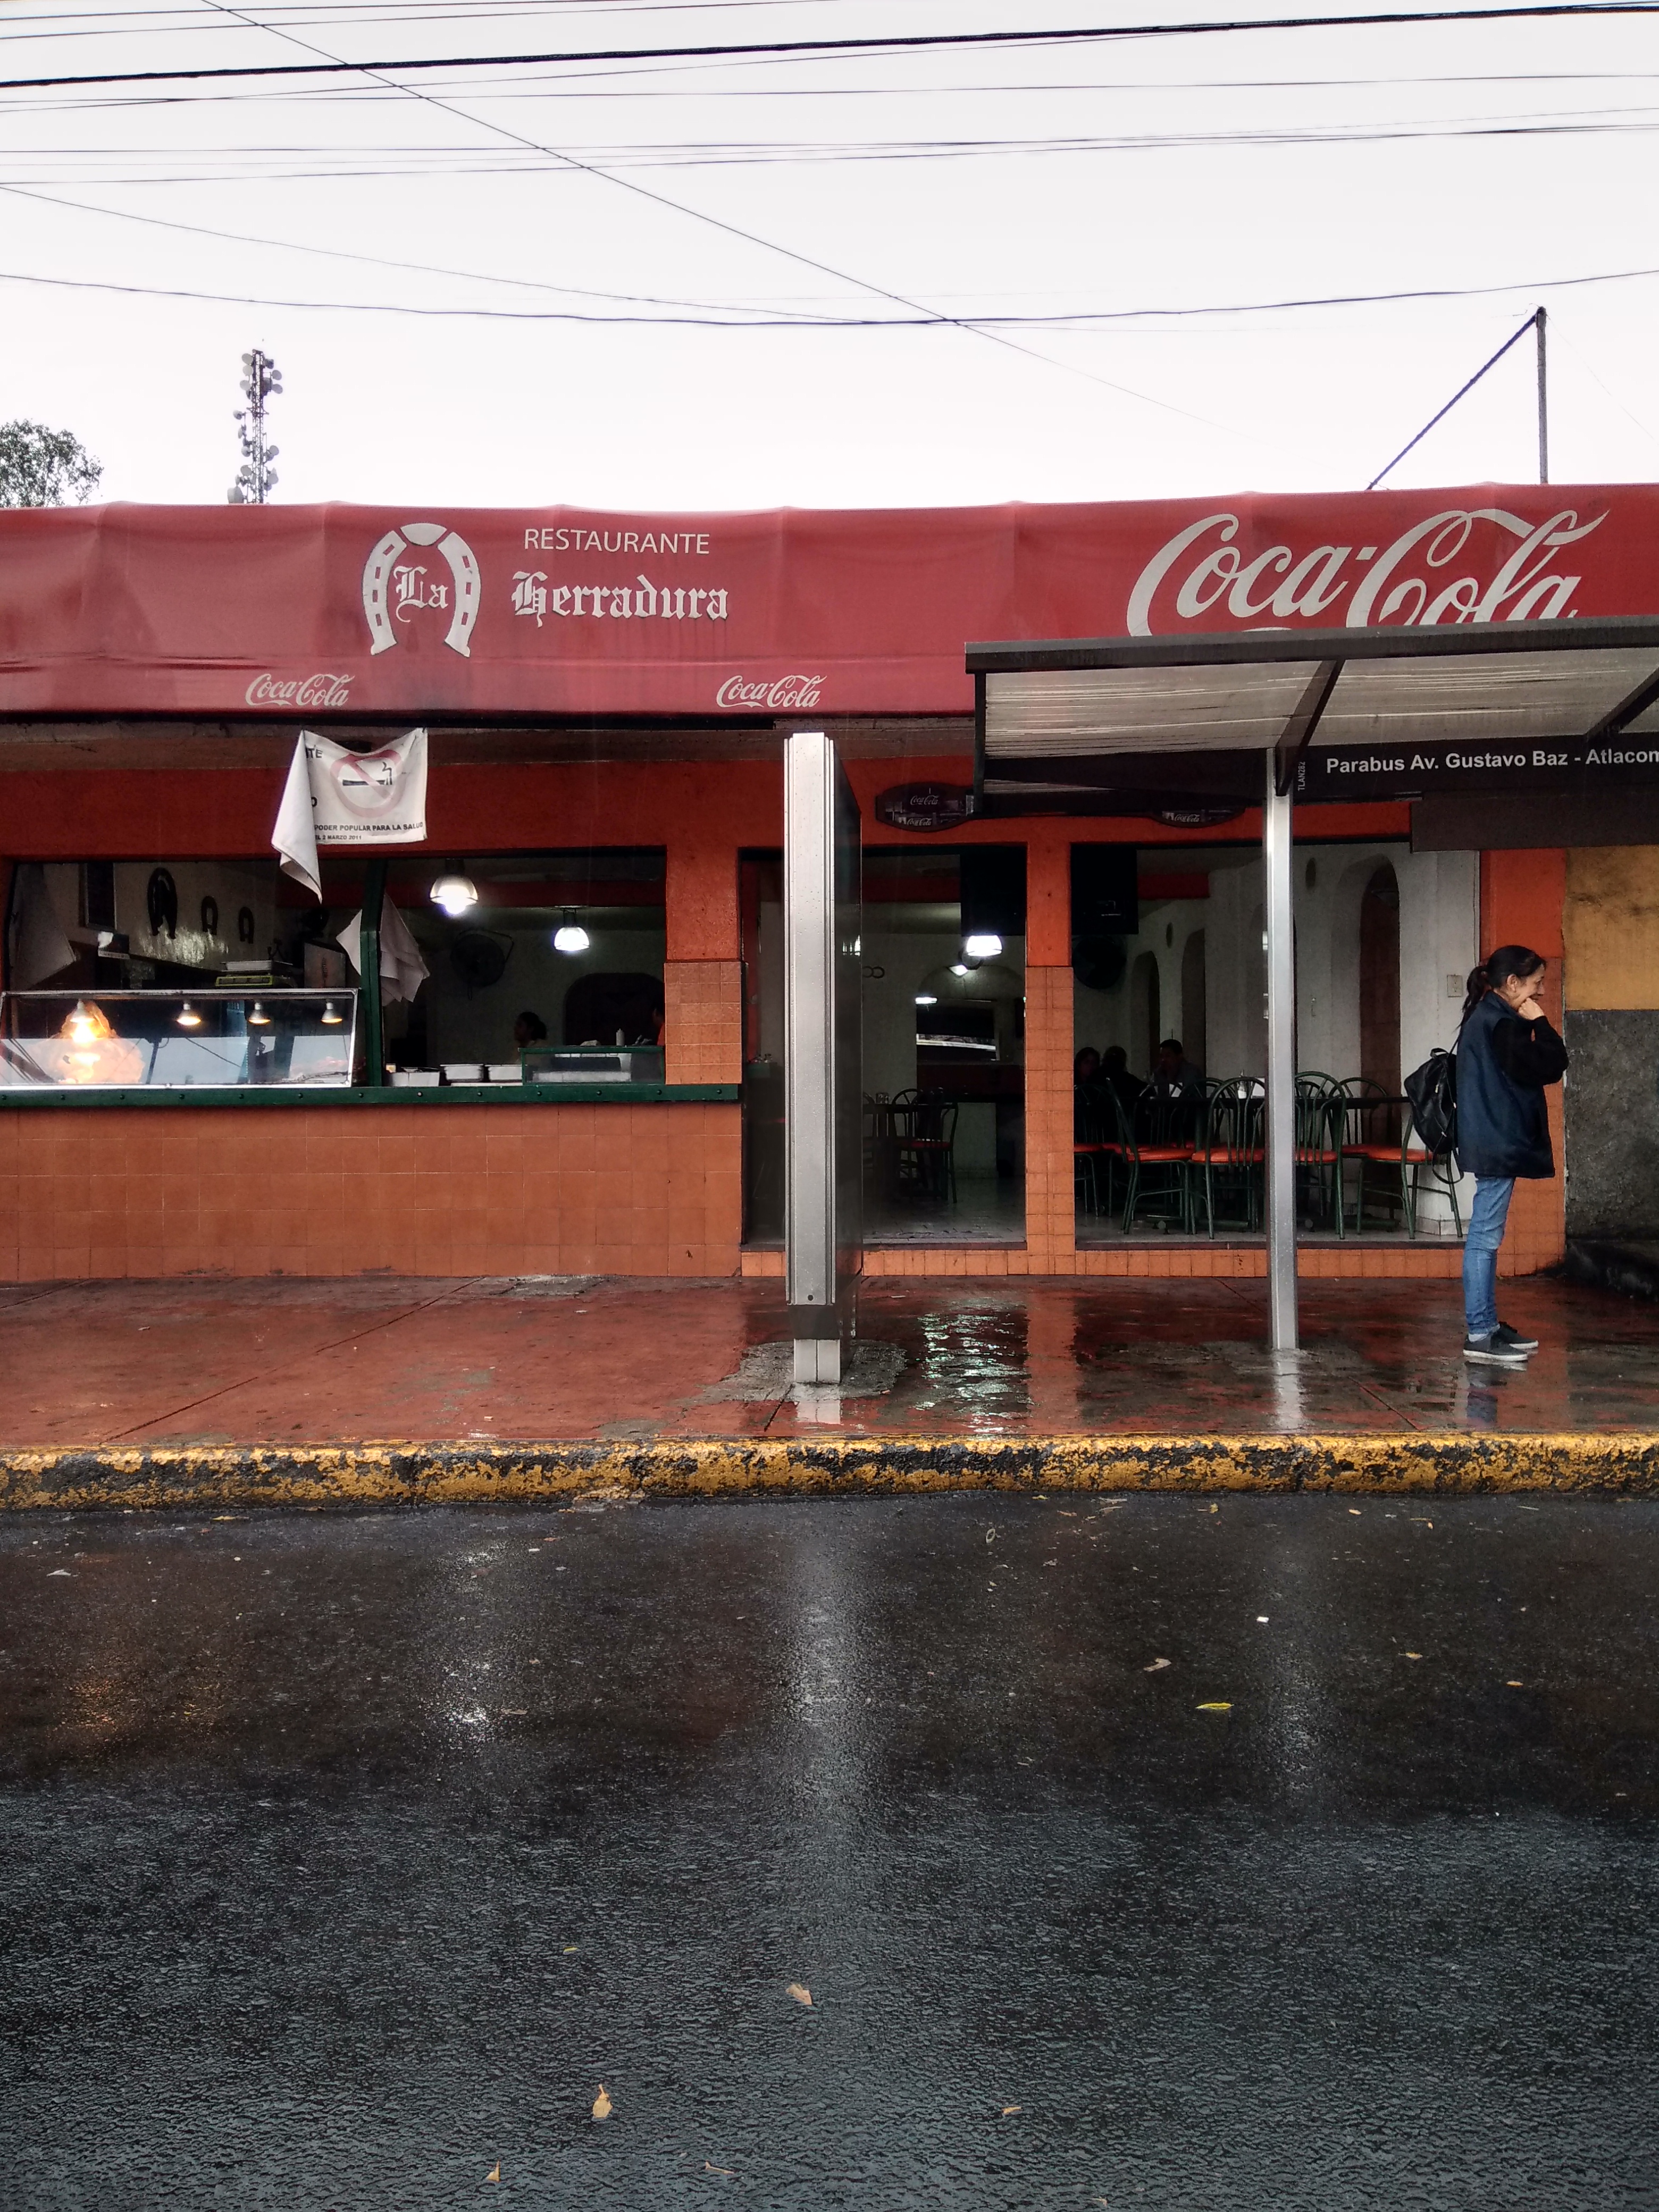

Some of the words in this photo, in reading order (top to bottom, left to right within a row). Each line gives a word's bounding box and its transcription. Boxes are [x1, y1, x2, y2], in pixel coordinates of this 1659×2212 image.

[524, 528, 710, 555] RESTAURANTE
[1126, 508, 1610, 636] Coca-Cola
[393, 566, 448, 623] La
[511, 571, 728, 628] Herradura
[245, 673, 355, 707] Coca-Cola
[716, 675, 827, 708] Coca-Cola
[1297, 761, 1306, 791] TLAN282
[1327, 756, 1405, 773] Parabus
[1410, 754, 1439, 770] Av.
[1446, 752, 1526, 768] Gustavo
[1532, 750, 1568, 766] Baz
[403, 822, 423, 830] SALUD
